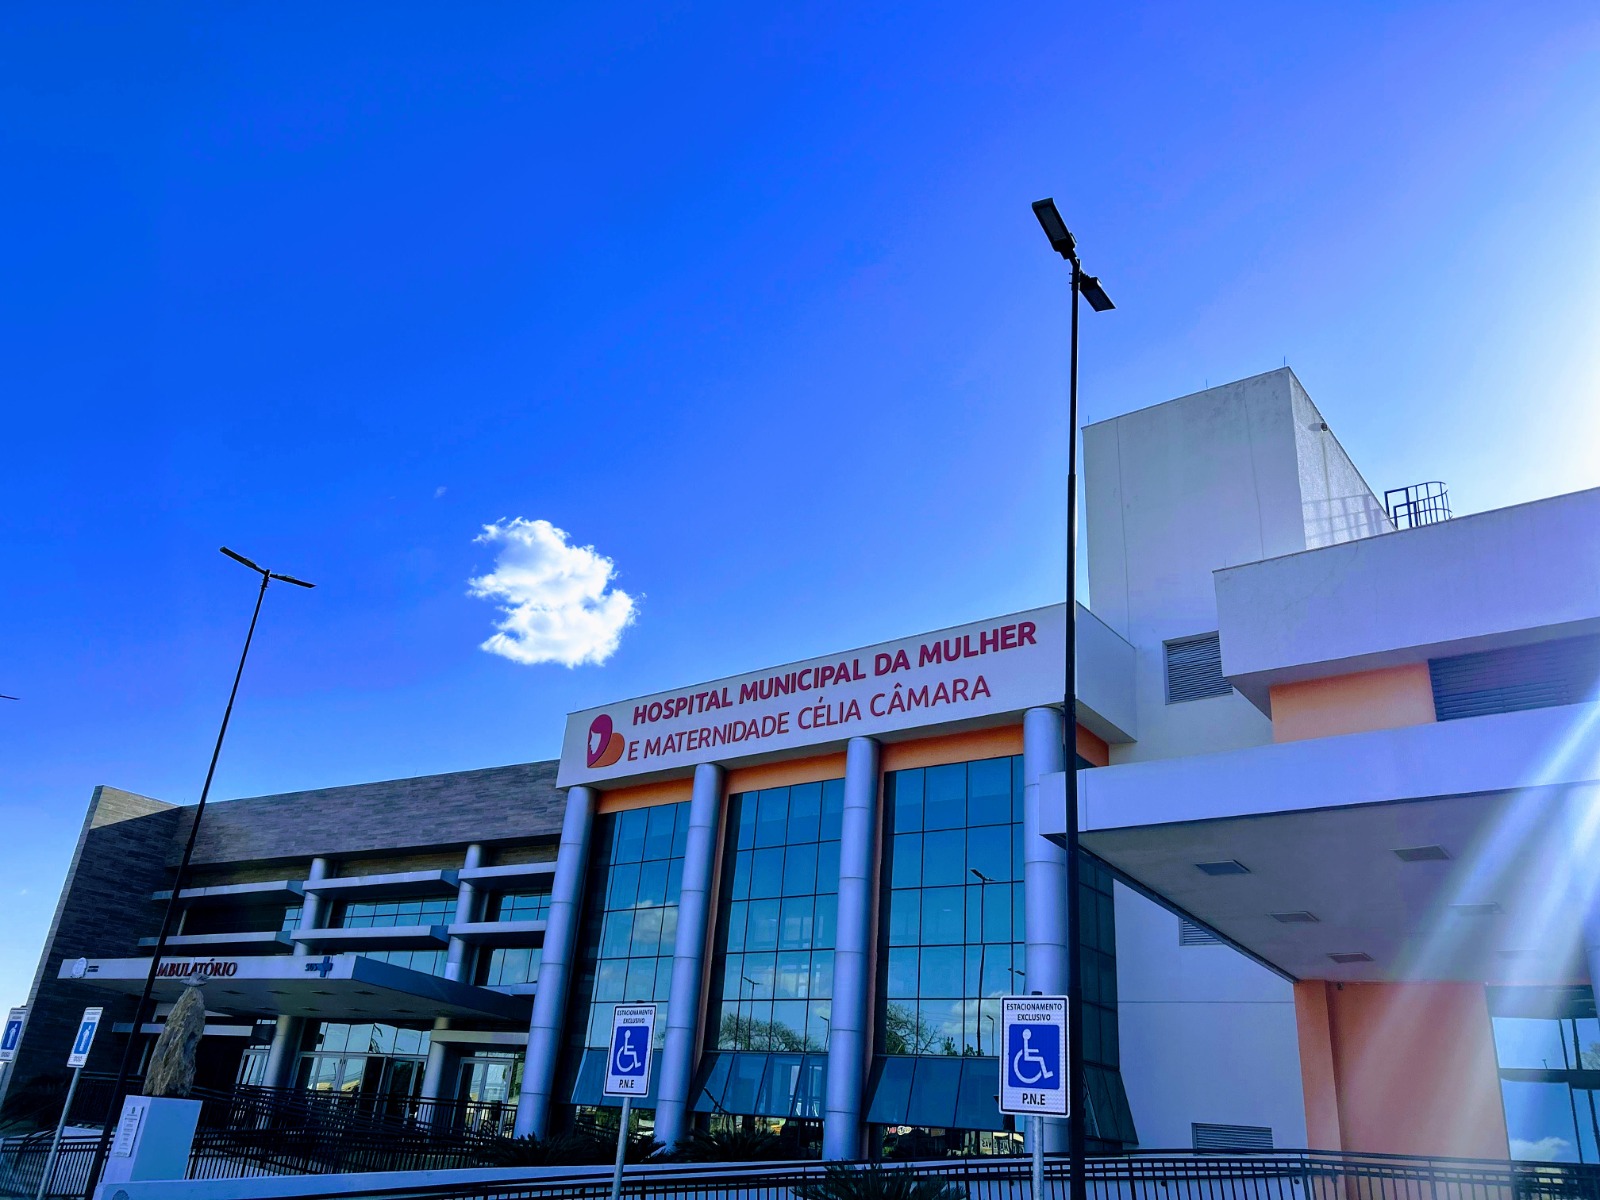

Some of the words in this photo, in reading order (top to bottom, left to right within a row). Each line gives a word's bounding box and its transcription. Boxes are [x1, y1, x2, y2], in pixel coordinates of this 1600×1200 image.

[633, 686, 733, 726] HOSPITAL
[739, 658, 867, 702] MUNICIPAL
[874, 648, 910, 677] DA
[919, 621, 1037, 669] MULHER
[628, 741, 639, 762] E
[644, 711, 790, 757] MATERNIDADE
[797, 696, 862, 730] CÉLIA
[869, 675, 991, 718] CÂMARA
[155, 958, 238, 977] MBULATÓRIO
[1006, 1003, 1063, 1011] ESTACIONAMENTO
[1017, 1013, 1051, 1021] EXCLUSIVO
[618, 1079, 635, 1089] P.N.E
[1022, 1092, 1046, 1106] P.N.E
